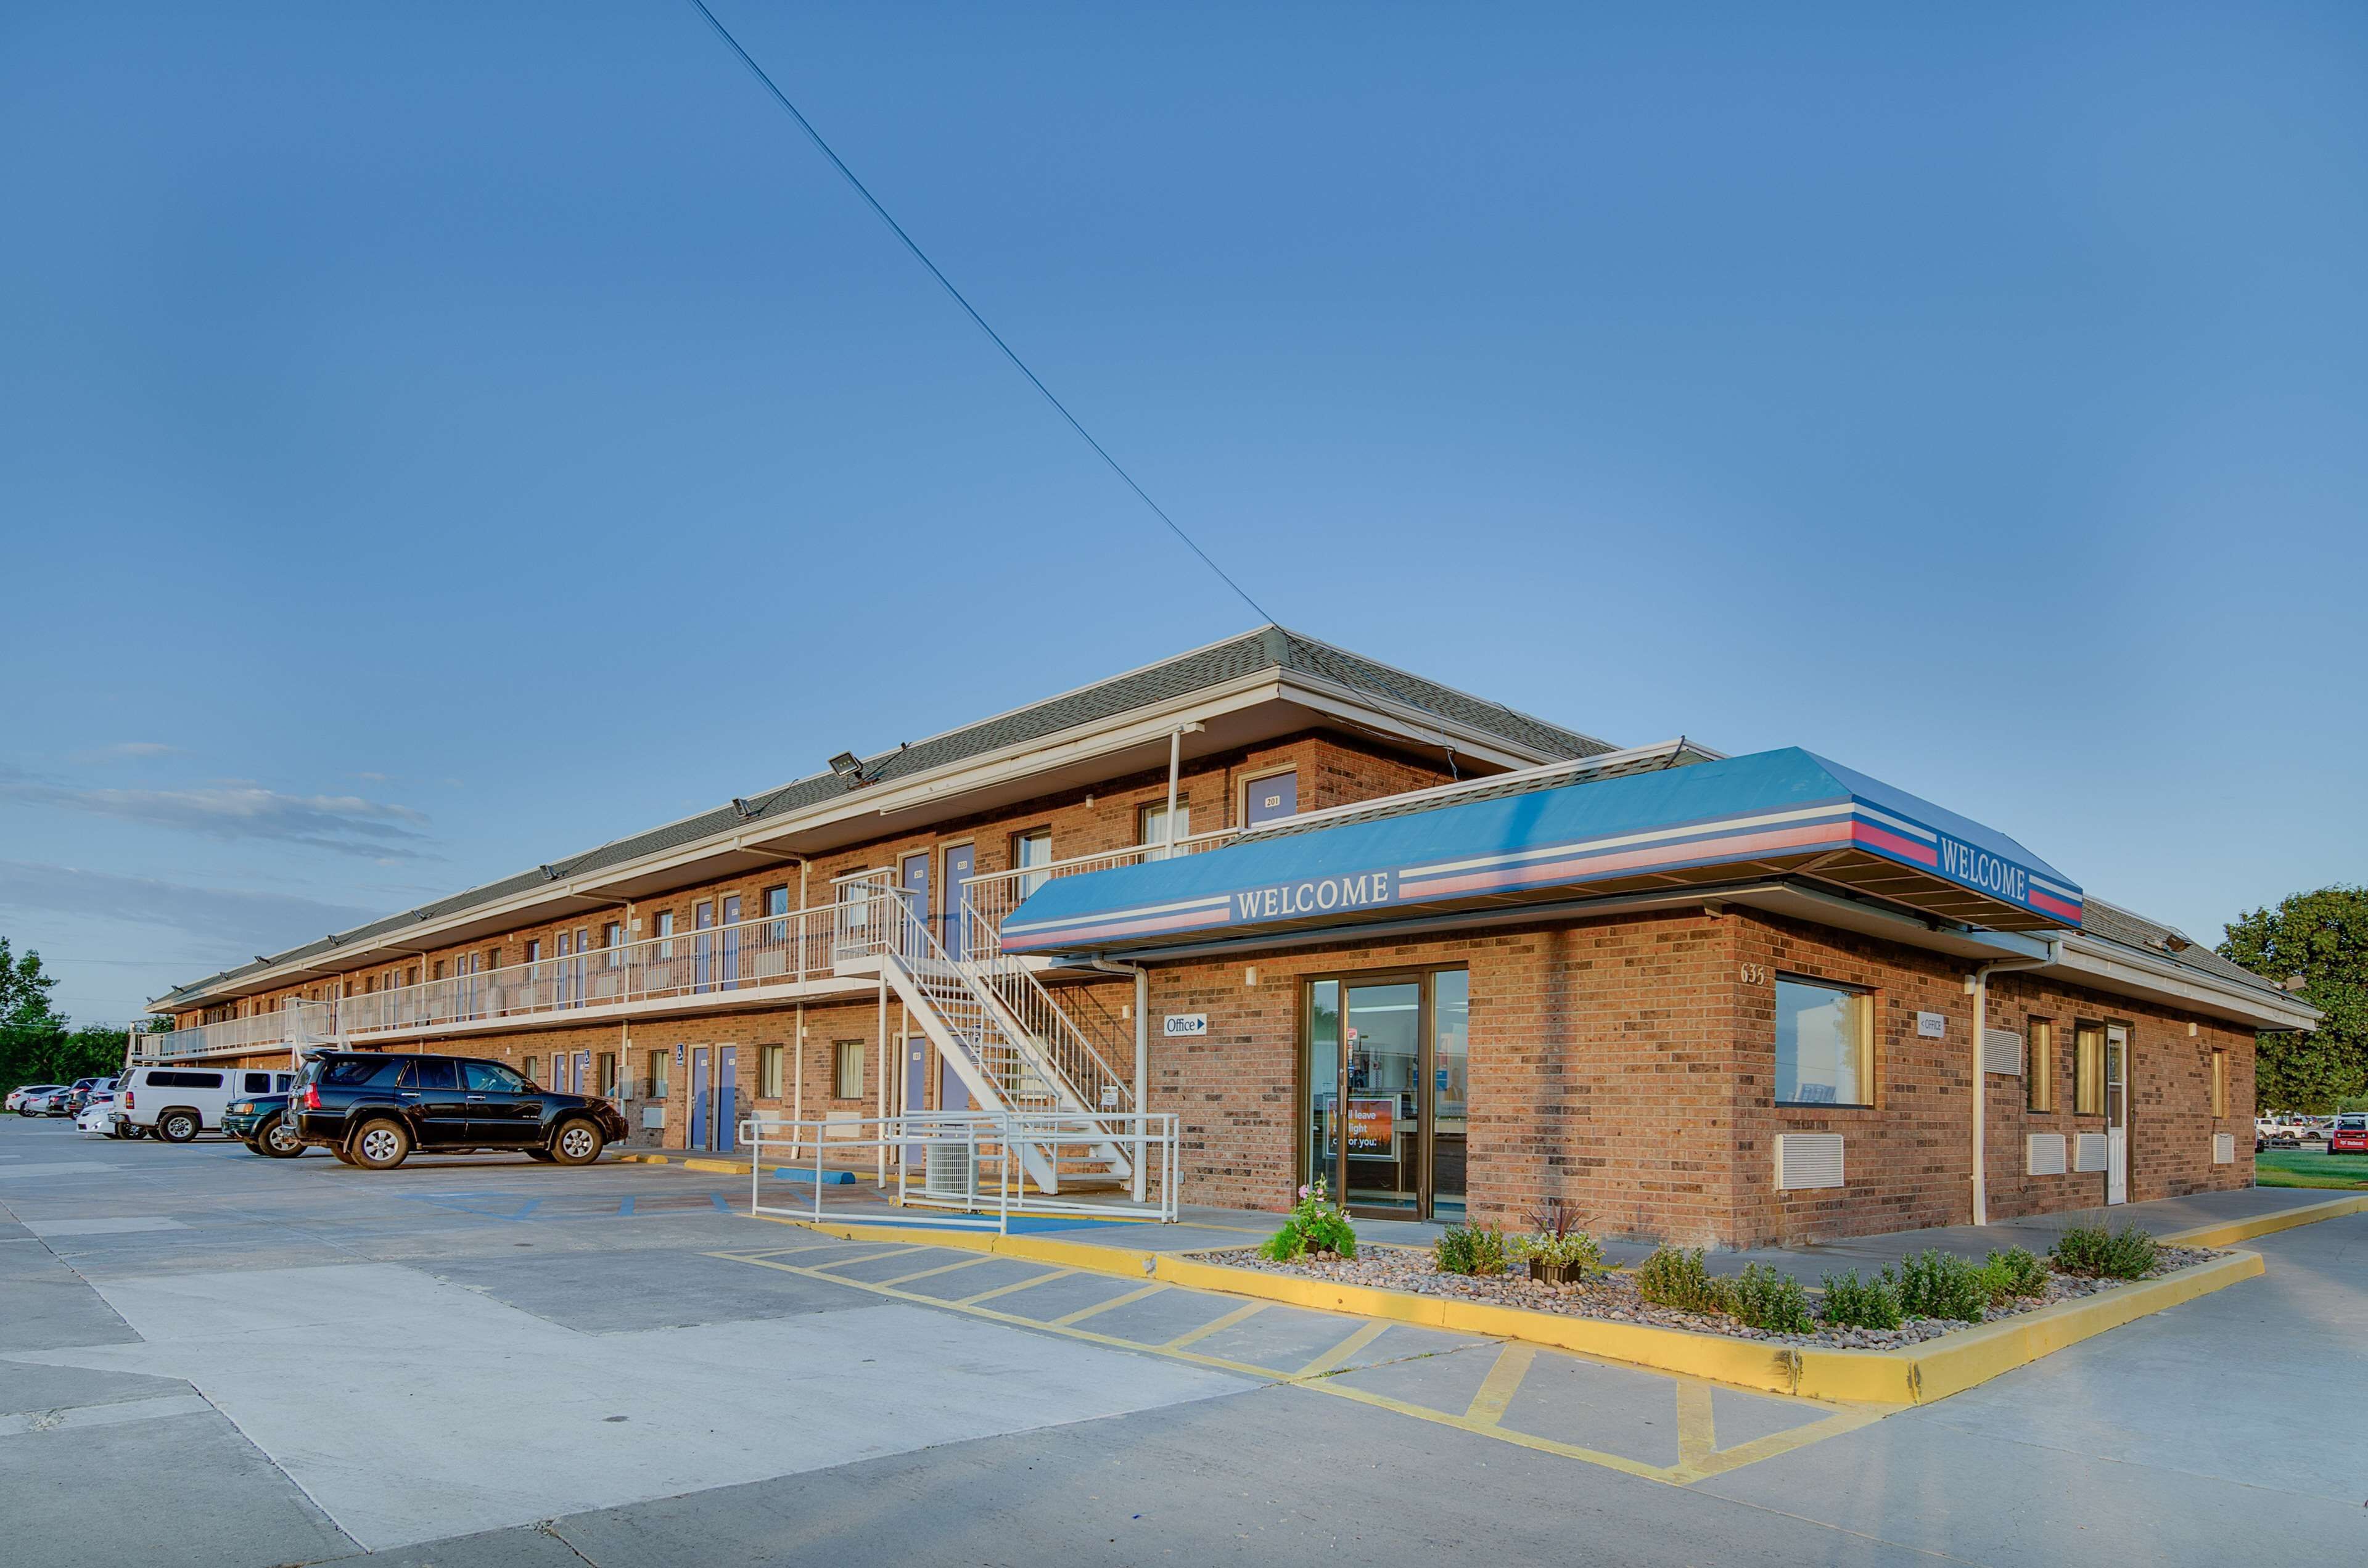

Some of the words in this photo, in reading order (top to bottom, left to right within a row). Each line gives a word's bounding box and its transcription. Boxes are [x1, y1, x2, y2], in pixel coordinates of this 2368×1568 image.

[1267, 797, 1278, 806] 201
[1941, 837, 2025, 901] WELCOME
[1237, 872, 1389, 919] WELCOME
[1741, 963, 1764, 985] 635
[1167, 1018, 1195, 1032] Office
[1925, 1019, 1941, 1031] OFFICE
[1355, 1109, 1376, 1120] leave
[1349, 1123, 1367, 1135] light
